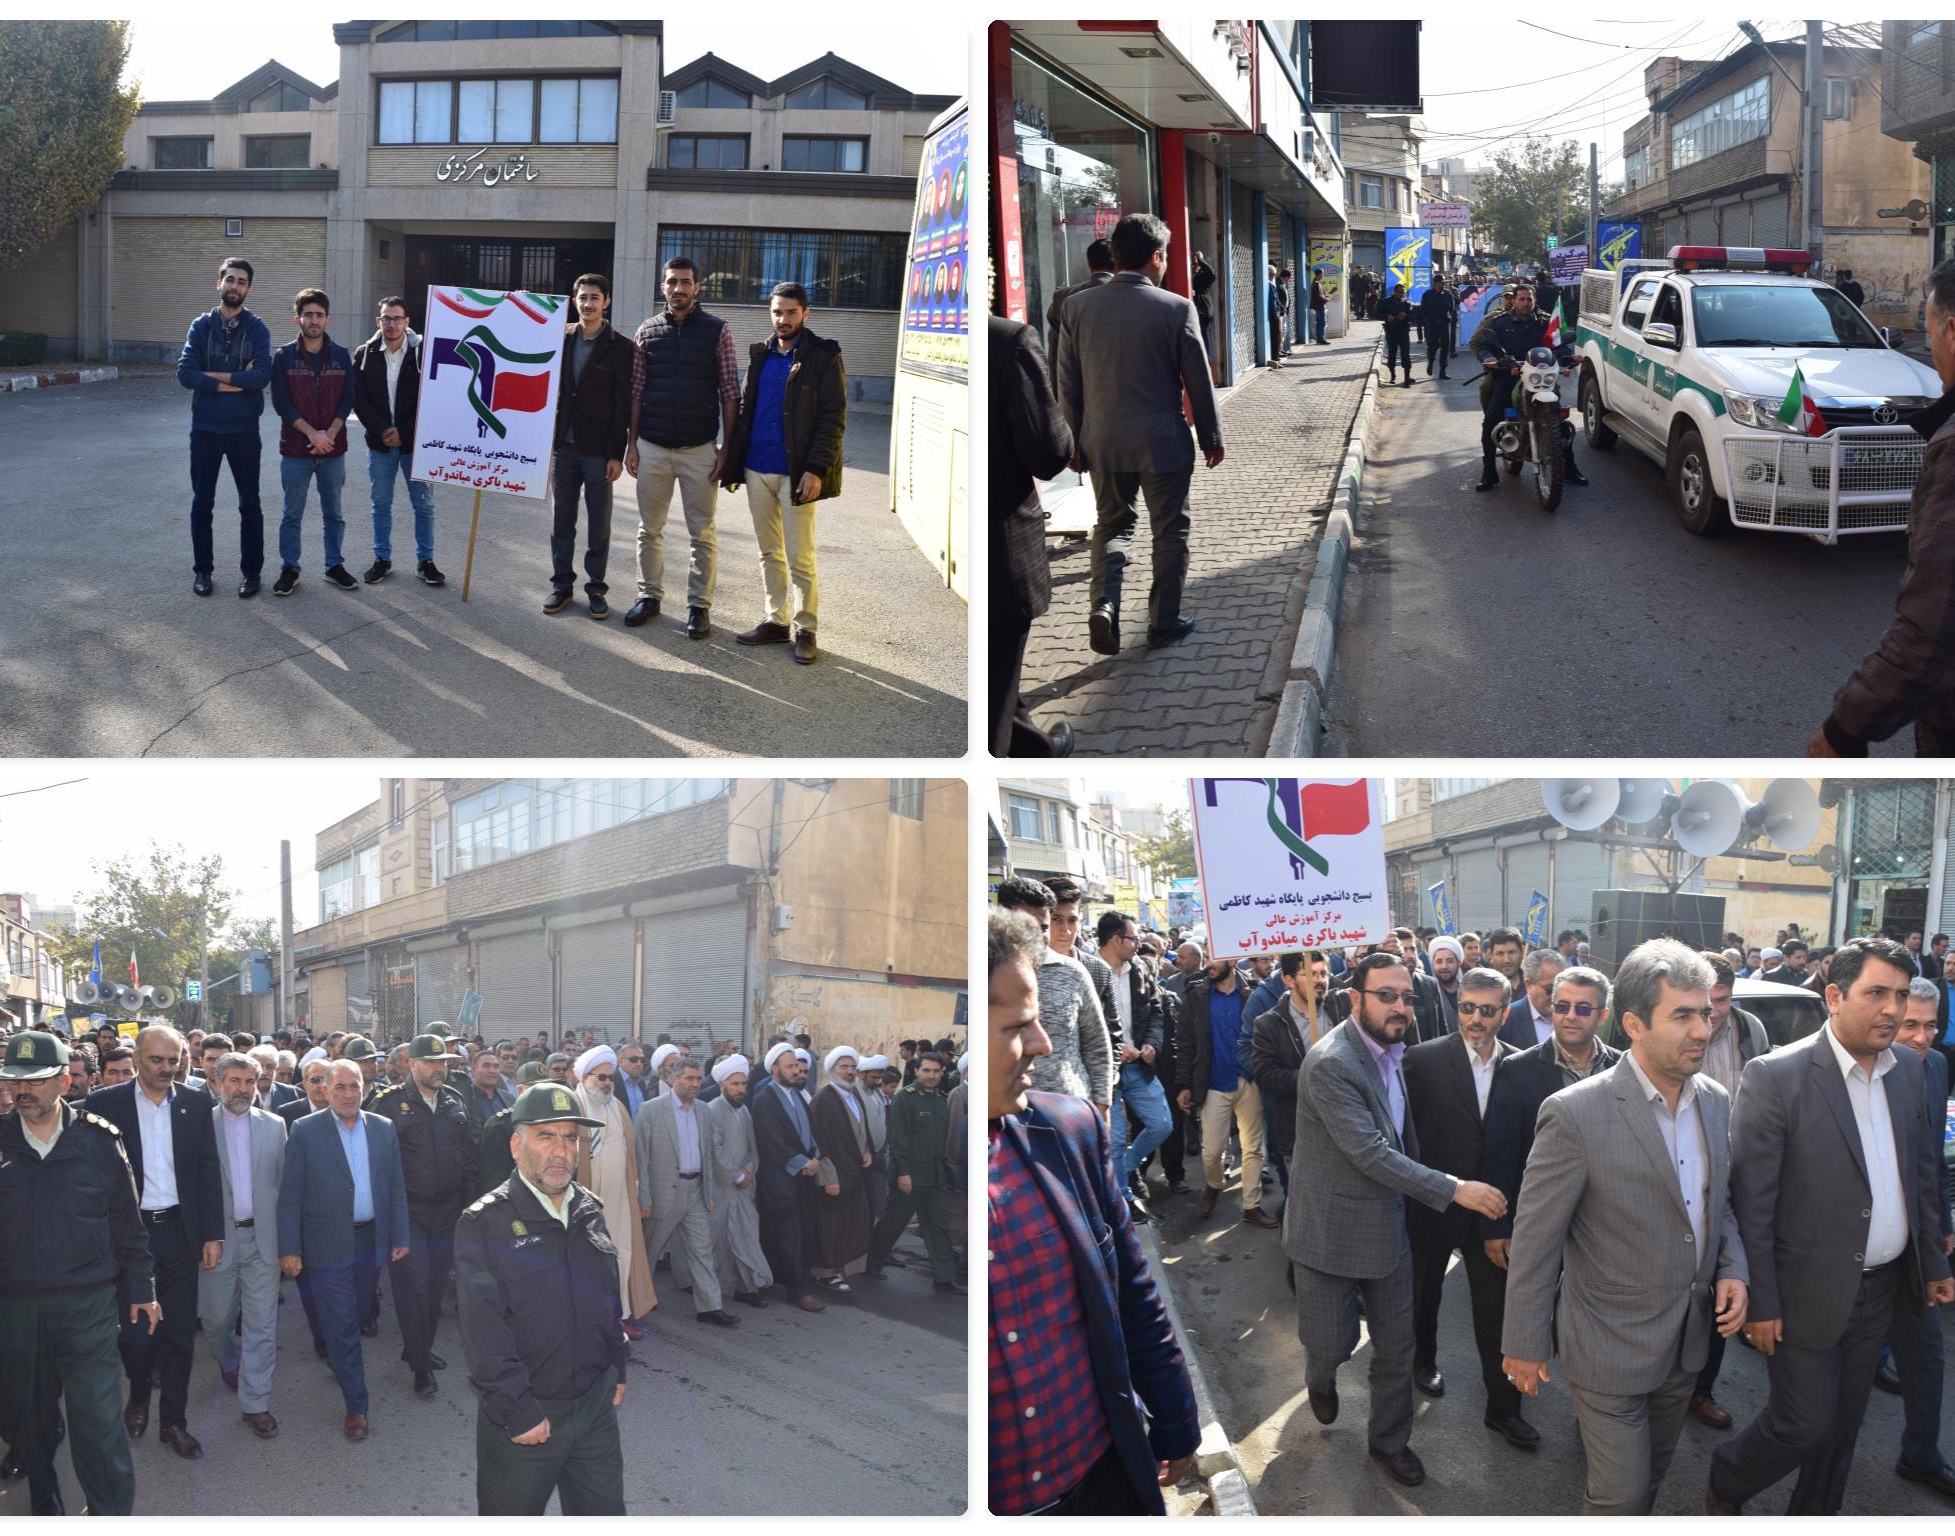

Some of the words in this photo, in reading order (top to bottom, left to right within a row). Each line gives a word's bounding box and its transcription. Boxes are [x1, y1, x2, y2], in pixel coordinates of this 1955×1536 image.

[436, 146, 488, 182] مرکزی
[483, 154, 540, 187] ساختمان
[421, 439, 446, 449] کاظمی
[445, 443, 462, 453] شهید
[463, 444, 482, 457] پایگاه
[484, 448, 519, 461] دانشجویی
[520, 455, 537, 466] بسیج
[450, 458, 466, 467] عالی
[466, 460, 491, 472] آموزش
[492, 464, 509, 475] مرکز
[472, 475, 501, 488] باکری
[503, 480, 527, 493] شهید
[1218, 894, 1252, 912] کاظمی
[1254, 893, 1277, 907] شهید
[1278, 891, 1304, 907] پایگاه
[1307, 889, 1351, 907] دانشجویی
[1351, 890, 1373, 903] بسیج
[1265, 914, 1287, 928] عالی
[1288, 910, 1320, 926] آموزش
[1322, 910, 1342, 925] مرکز
[1301, 926, 1337, 948] باکری
[1340, 925, 1367, 943] شهید
